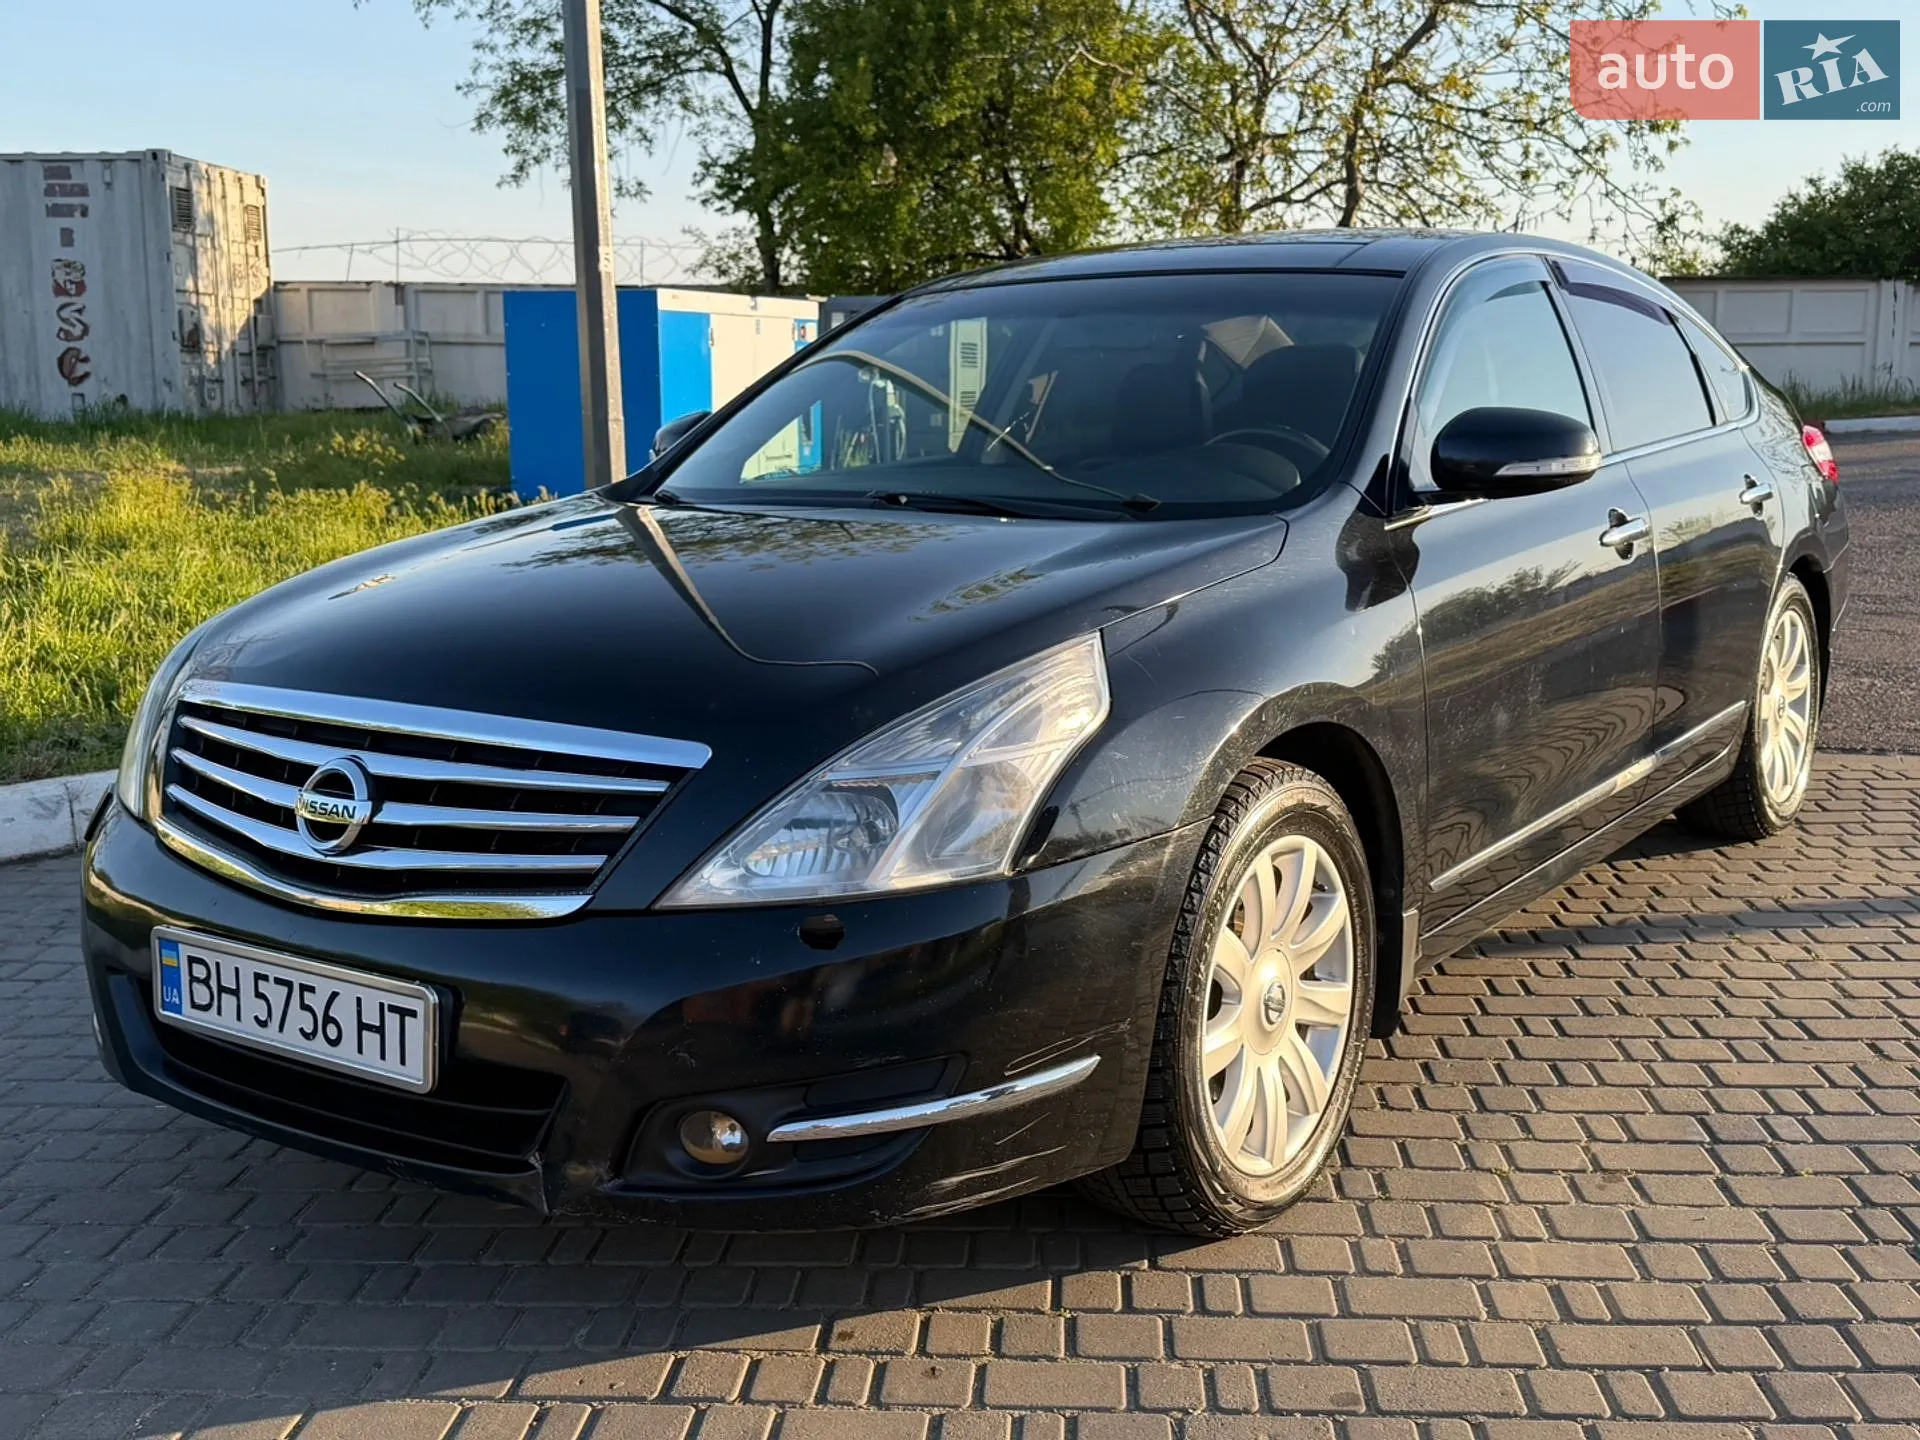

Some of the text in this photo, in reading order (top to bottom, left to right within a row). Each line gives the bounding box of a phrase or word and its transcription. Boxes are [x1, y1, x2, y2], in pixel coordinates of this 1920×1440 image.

[299, 799, 356, 819] NISSAN
[163, 985, 180, 1005] UA
[187, 954, 418, 1067] BH 5756 HT
